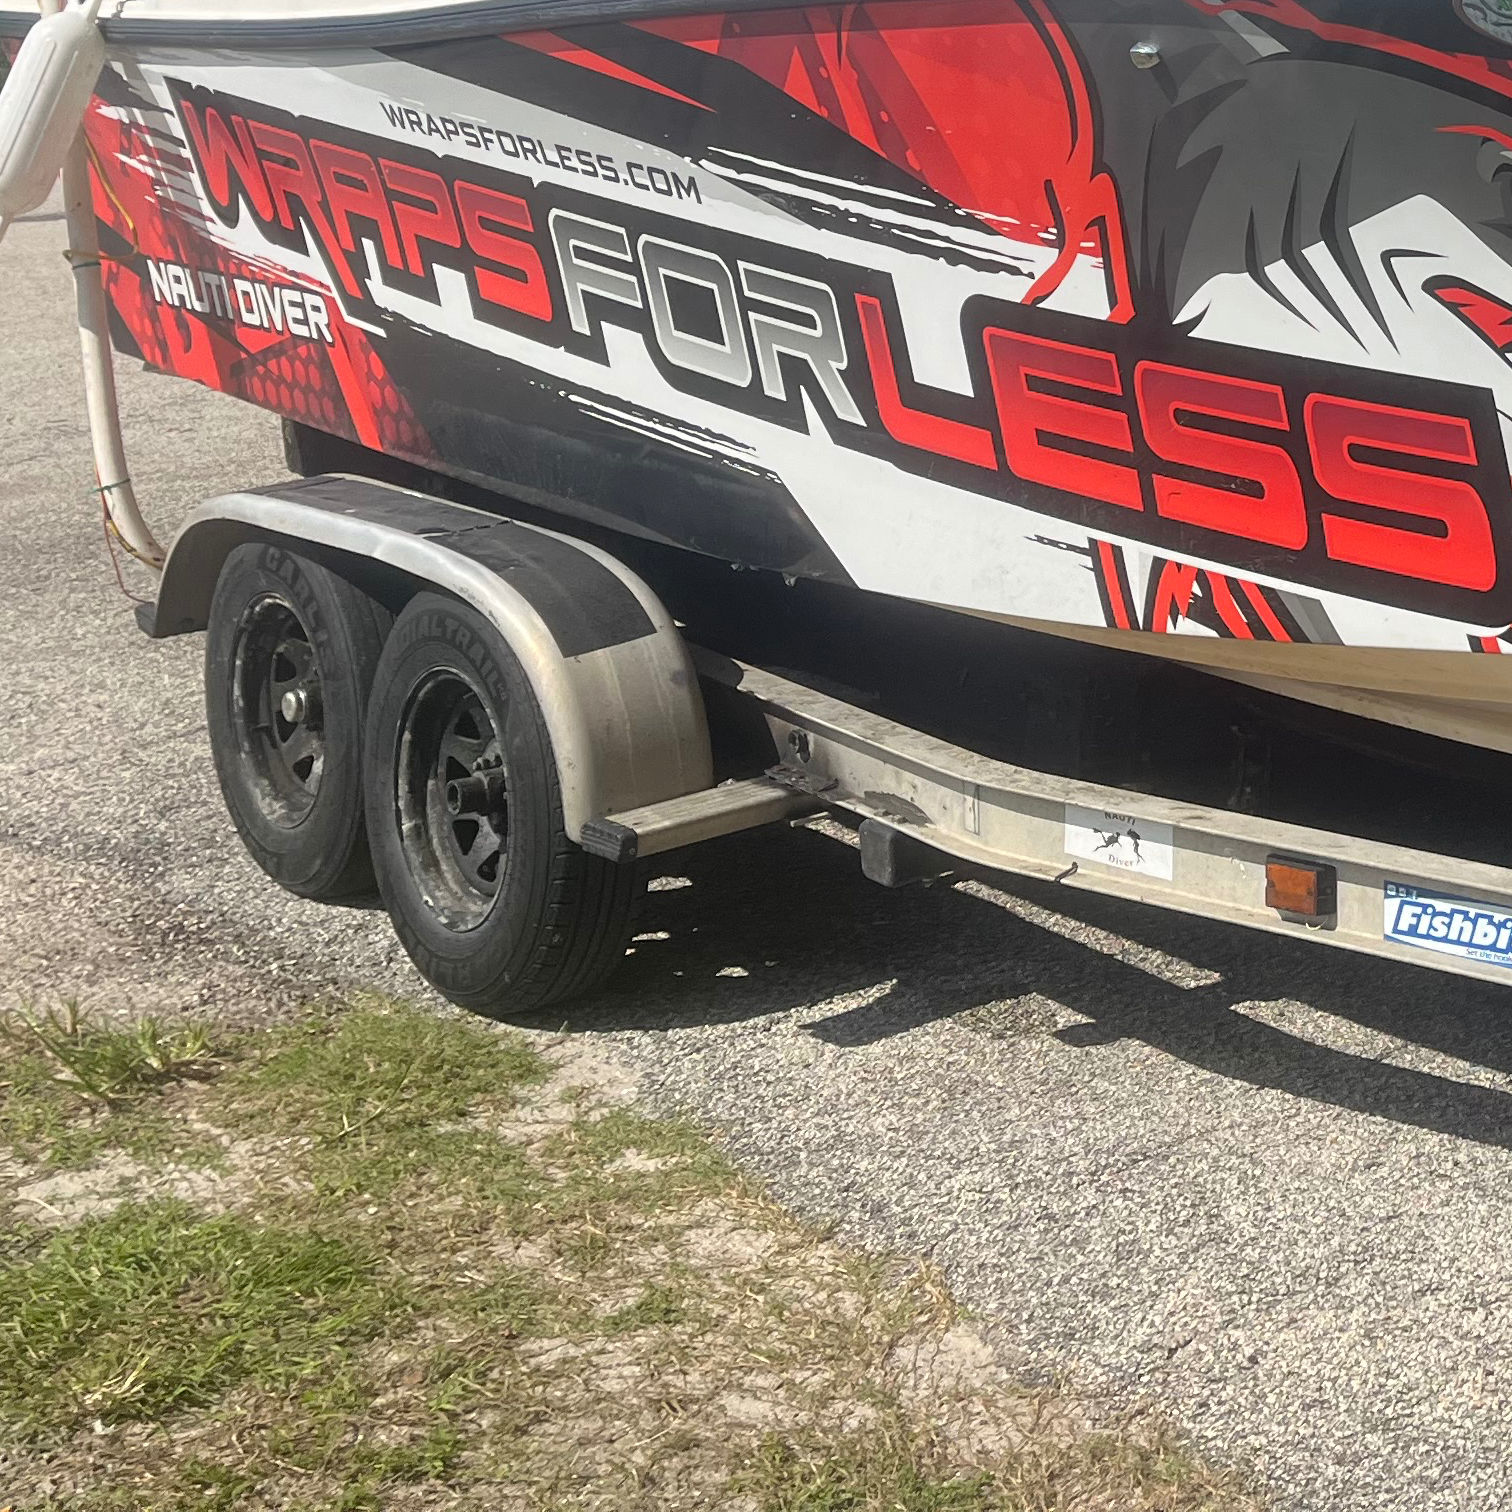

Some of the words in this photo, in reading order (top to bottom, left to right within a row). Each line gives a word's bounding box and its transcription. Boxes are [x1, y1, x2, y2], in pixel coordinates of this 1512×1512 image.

[378, 101, 703, 205] WRAPSFORLESS.COM
[146, 258, 235, 320] NAUTI
[233, 278, 333, 344] DIVER
[1103, 811, 1136, 826] NAUTI
[1108, 853, 1134, 867] Diver
